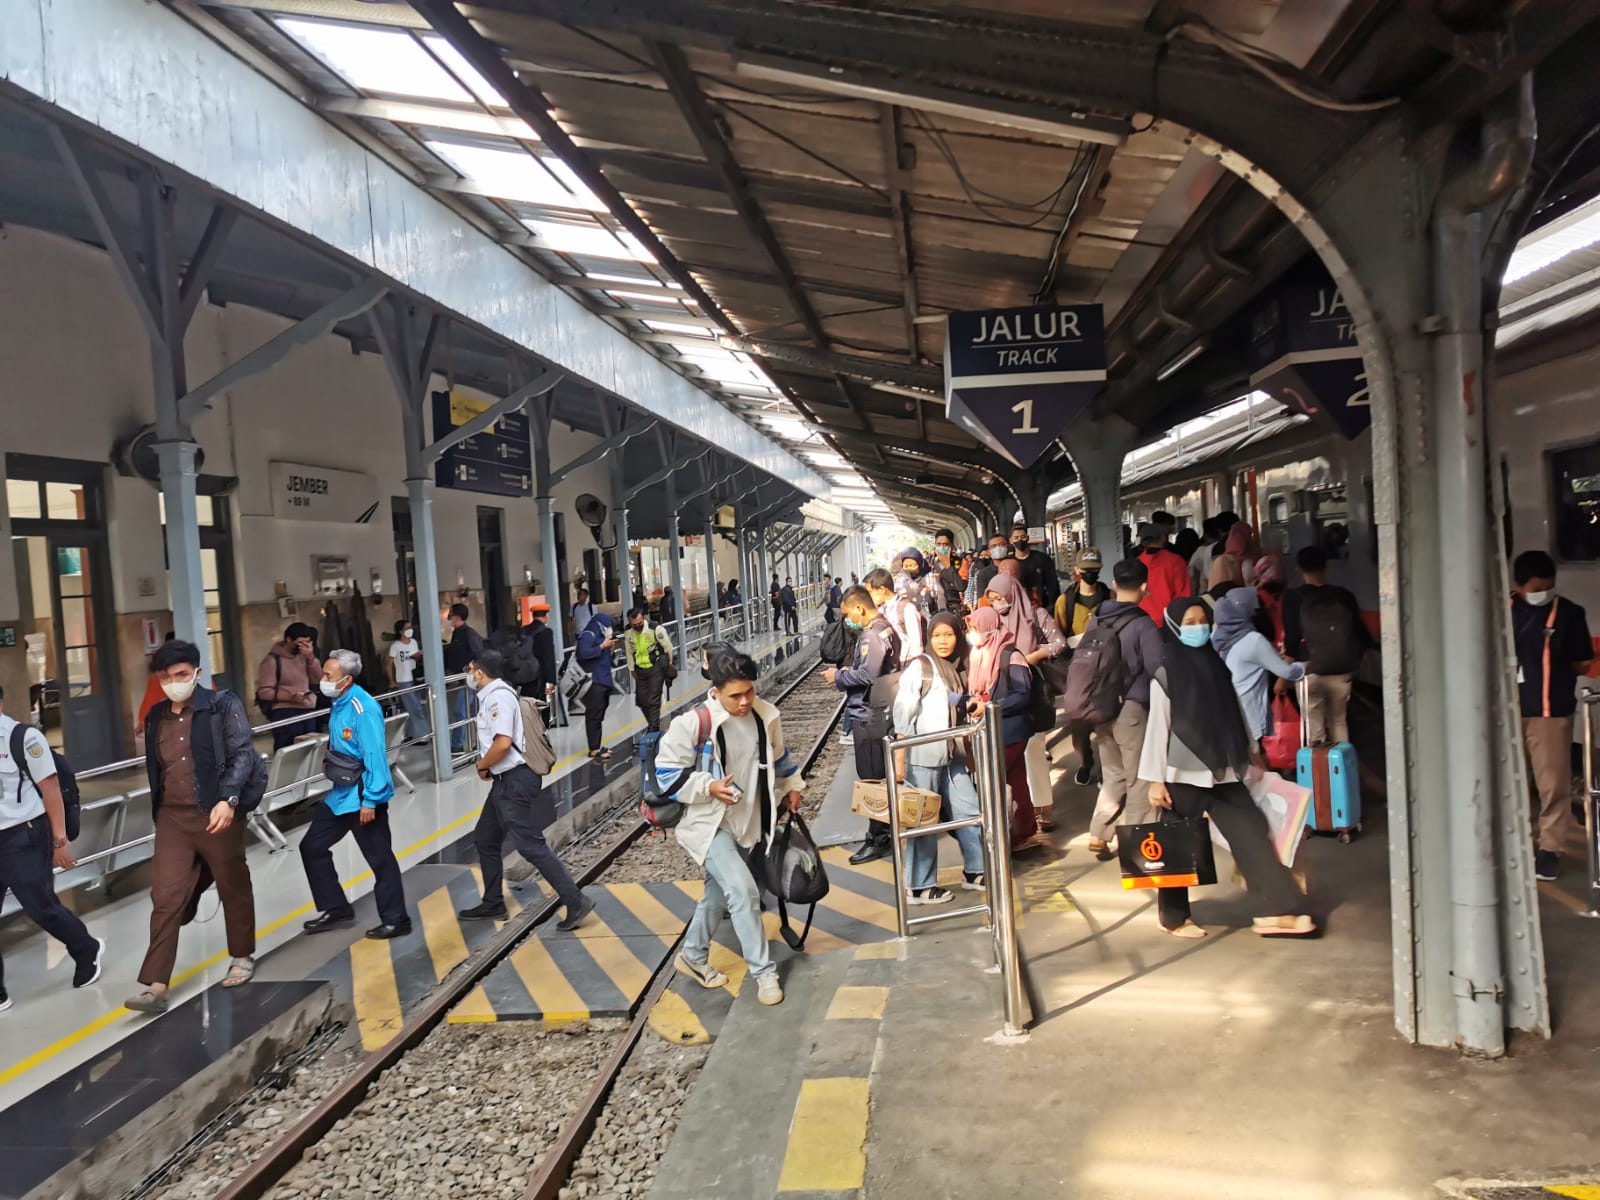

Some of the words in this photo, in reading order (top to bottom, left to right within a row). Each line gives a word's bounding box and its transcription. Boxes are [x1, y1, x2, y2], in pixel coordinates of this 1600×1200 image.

[972, 311, 1082, 343] JALUR
[997, 348, 1059, 366] TRACK
[1011, 399, 1040, 434] 1
[287, 475, 328, 495] JEMBER
